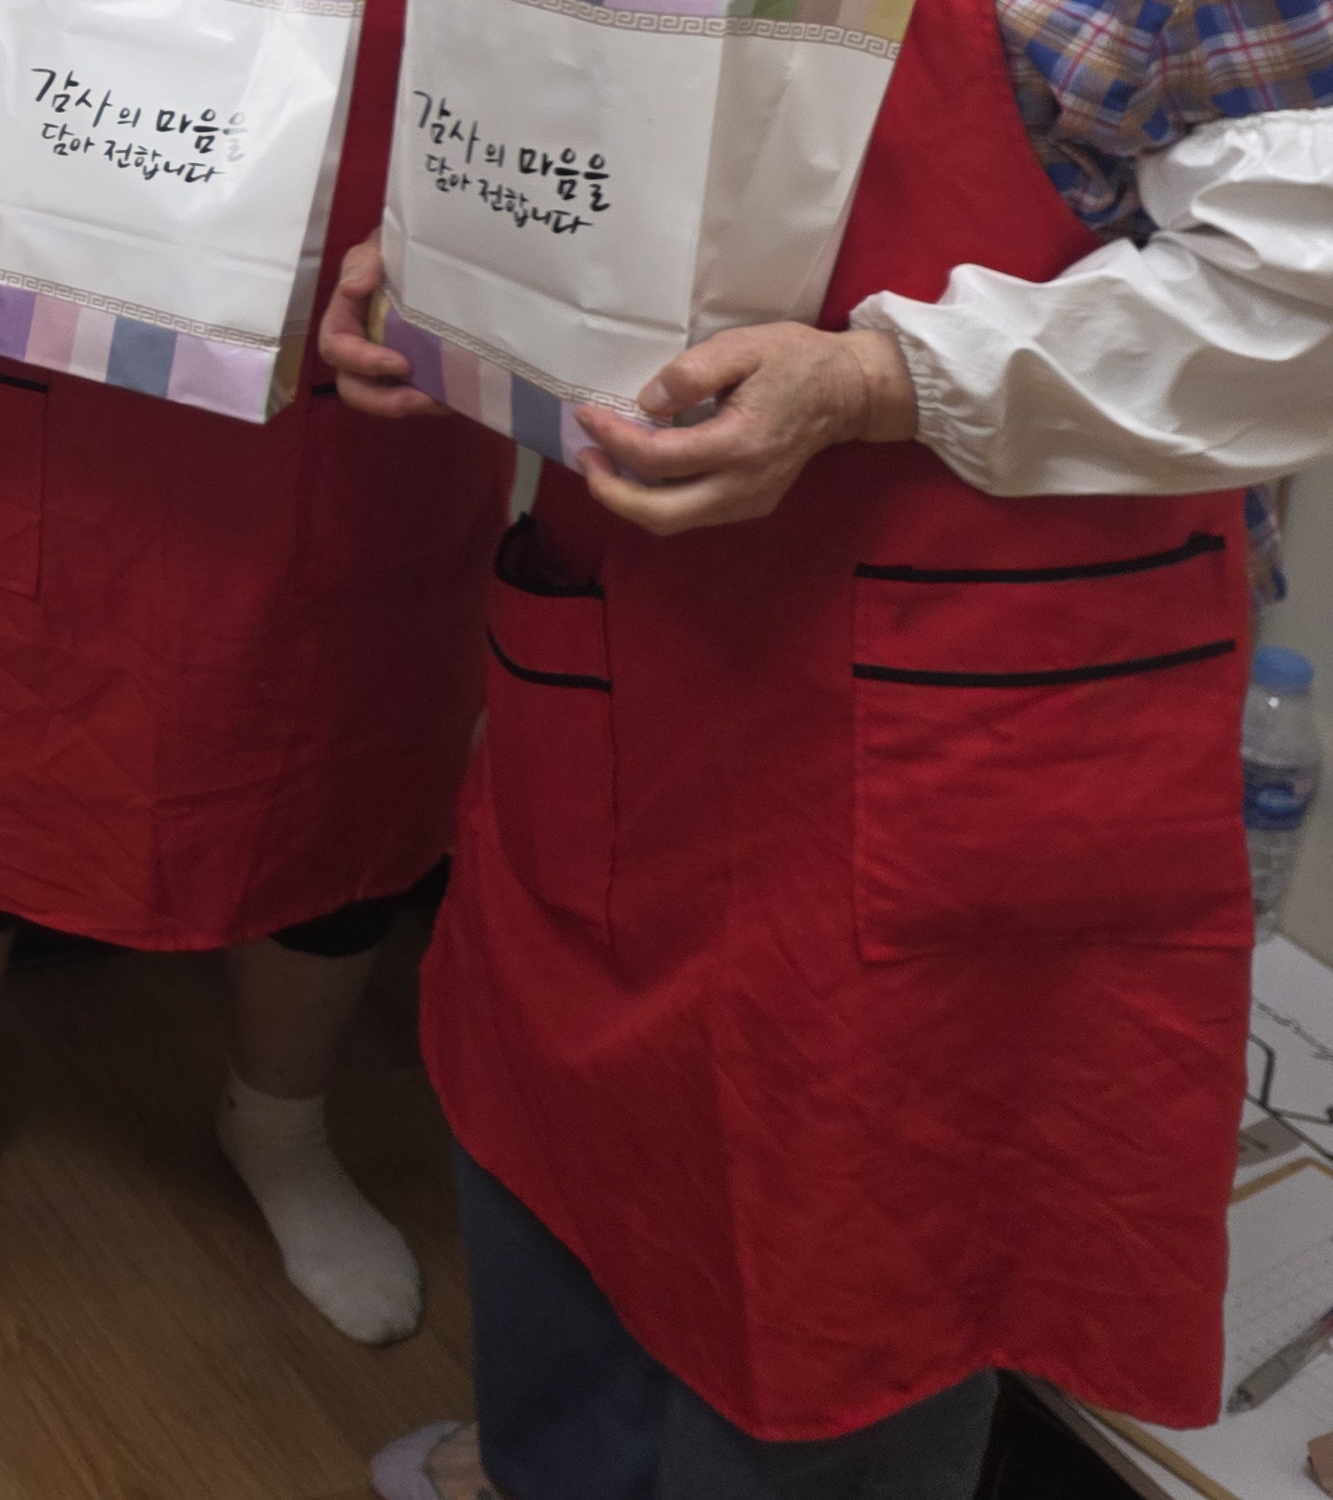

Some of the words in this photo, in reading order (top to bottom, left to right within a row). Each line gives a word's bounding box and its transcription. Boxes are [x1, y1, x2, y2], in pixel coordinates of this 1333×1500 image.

[31, 68, 142, 128] 감사의
[156, 108, 249, 162] 마음을
[42, 122, 96, 156] 담아
[104, 140, 226, 183] 전합니다
[413, 90, 506, 168] 감사의
[519, 147, 611, 212] 마음을
[425, 153, 472, 193] 담아
[477, 179, 594, 234] 전합니다
